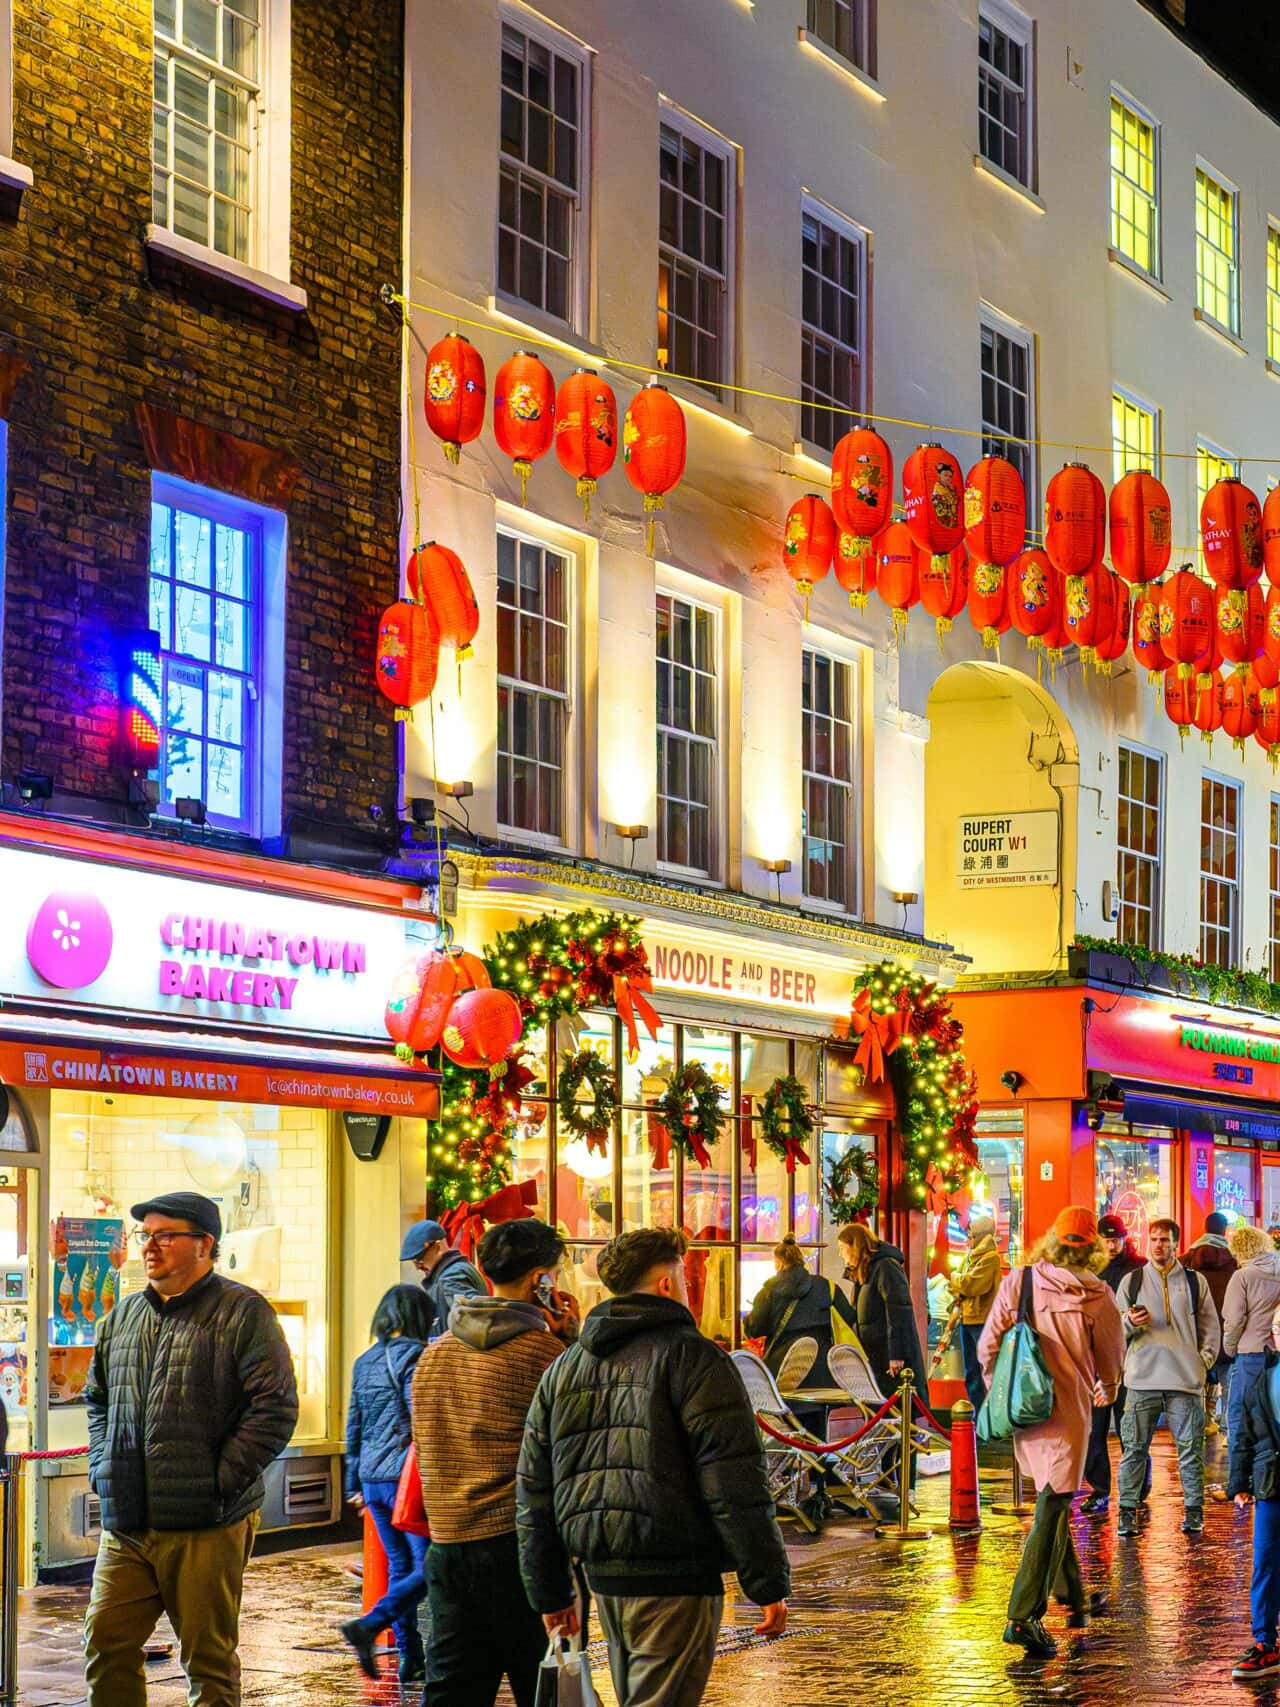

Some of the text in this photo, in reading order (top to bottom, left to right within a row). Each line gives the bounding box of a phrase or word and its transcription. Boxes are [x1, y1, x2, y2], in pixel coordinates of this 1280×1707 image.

[964, 820, 1012, 836] RUPERT
[964, 836, 1027, 853] COURT W1
[963, 875, 1026, 886] CITY OF WESTMINSTER
[160, 912, 366, 974] CHINATOWN
[160, 960, 299, 1010] BAKERY
[655, 945, 816, 1004] NOODLE AND BEER
[52, 1060, 238, 1092] CHINATOWN BAKERY
